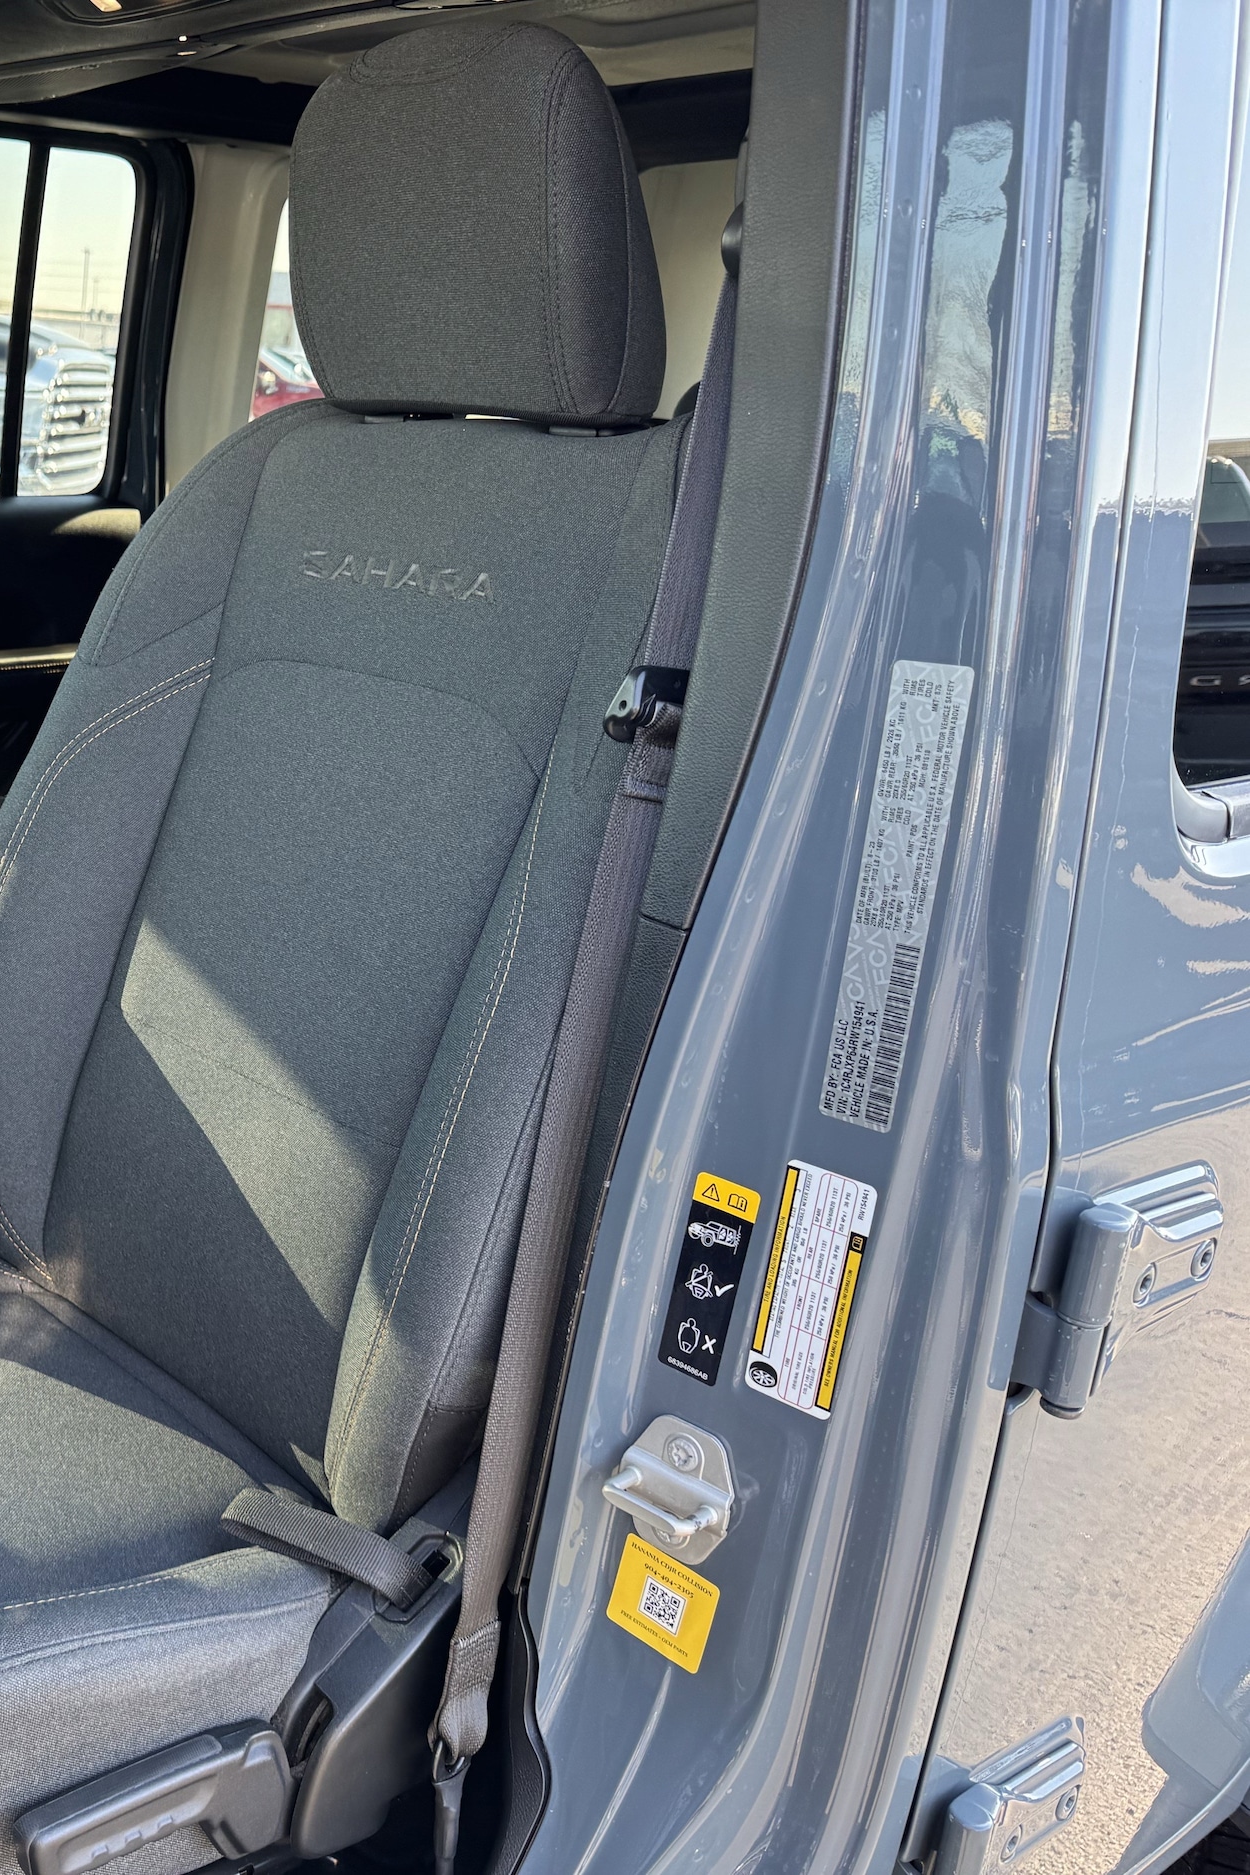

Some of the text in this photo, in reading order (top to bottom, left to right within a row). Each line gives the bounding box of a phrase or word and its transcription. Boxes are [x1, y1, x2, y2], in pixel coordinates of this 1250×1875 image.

[301, 550, 496, 604] SAHARA
[926, 682, 934, 698] COLD
[945, 681, 956, 704] SAFETY
[941, 705, 951, 730] VEHICLE
[937, 732, 946, 753] MOTOR
[947, 726, 957, 749] SHOWN
[931, 755, 942, 782] FEDERAL
[938, 751, 953, 795] MANUFACTURE
[936, 797, 944, 806] OF
[881, 806, 889, 822] WITH
[903, 810, 912, 825] COLD
[921, 803, 934, 839] APPLICABLE
[933, 808, 942, 822] DATE
[931, 824, 939, 836] THE
[919, 840, 927, 851] ALL
[929, 837, 937, 847] ON
[917, 853, 925, 861] TO
[925, 848, 935, 869] EFFECT
[911, 862, 923, 894] CONFORMS
[907, 896, 917, 919] VEHICLE
[917, 879, 929, 914] STANDARDS
[856, 909, 865, 924] DATE
[824, 1019, 849, 1111] MFD BY: FCA US LLC
[837, 1000, 865, 1115] VIN: 1C4RJXP64RW154941
[850, 1007, 879, 1119] VEHICLE MADE IN: U.S.A.
[769, 1253, 778, 1278] LOADING
[774, 1215, 786, 1253] INFORMATION
[631, 1542, 660, 1564] HANANIA
[677, 1571, 713, 1597] COLLISION
[644, 1563, 695, 1599] 904-494-2305
